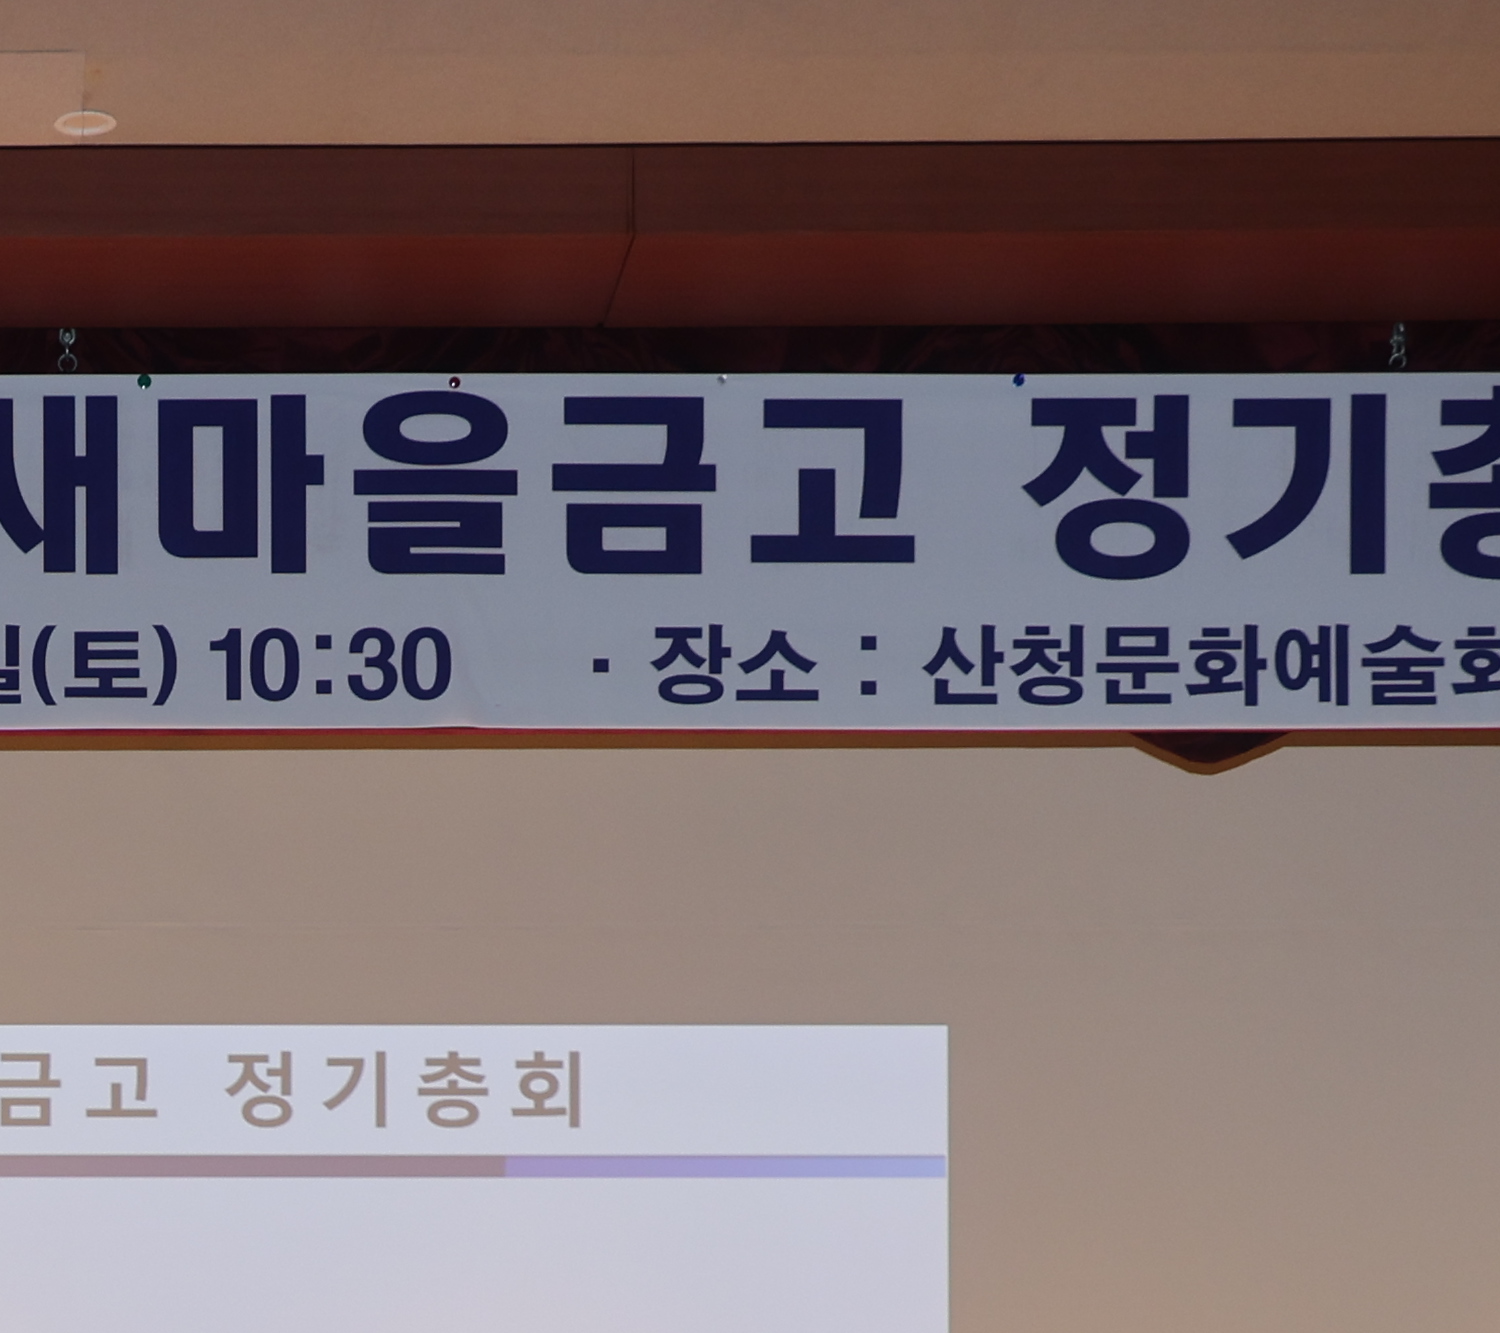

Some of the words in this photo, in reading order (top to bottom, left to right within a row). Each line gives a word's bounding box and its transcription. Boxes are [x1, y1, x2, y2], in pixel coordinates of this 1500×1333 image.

[210, 627, 452, 702] 10:30
[650, 624, 820, 705] 장소
[225, 1050, 586, 1129] 정기총회
